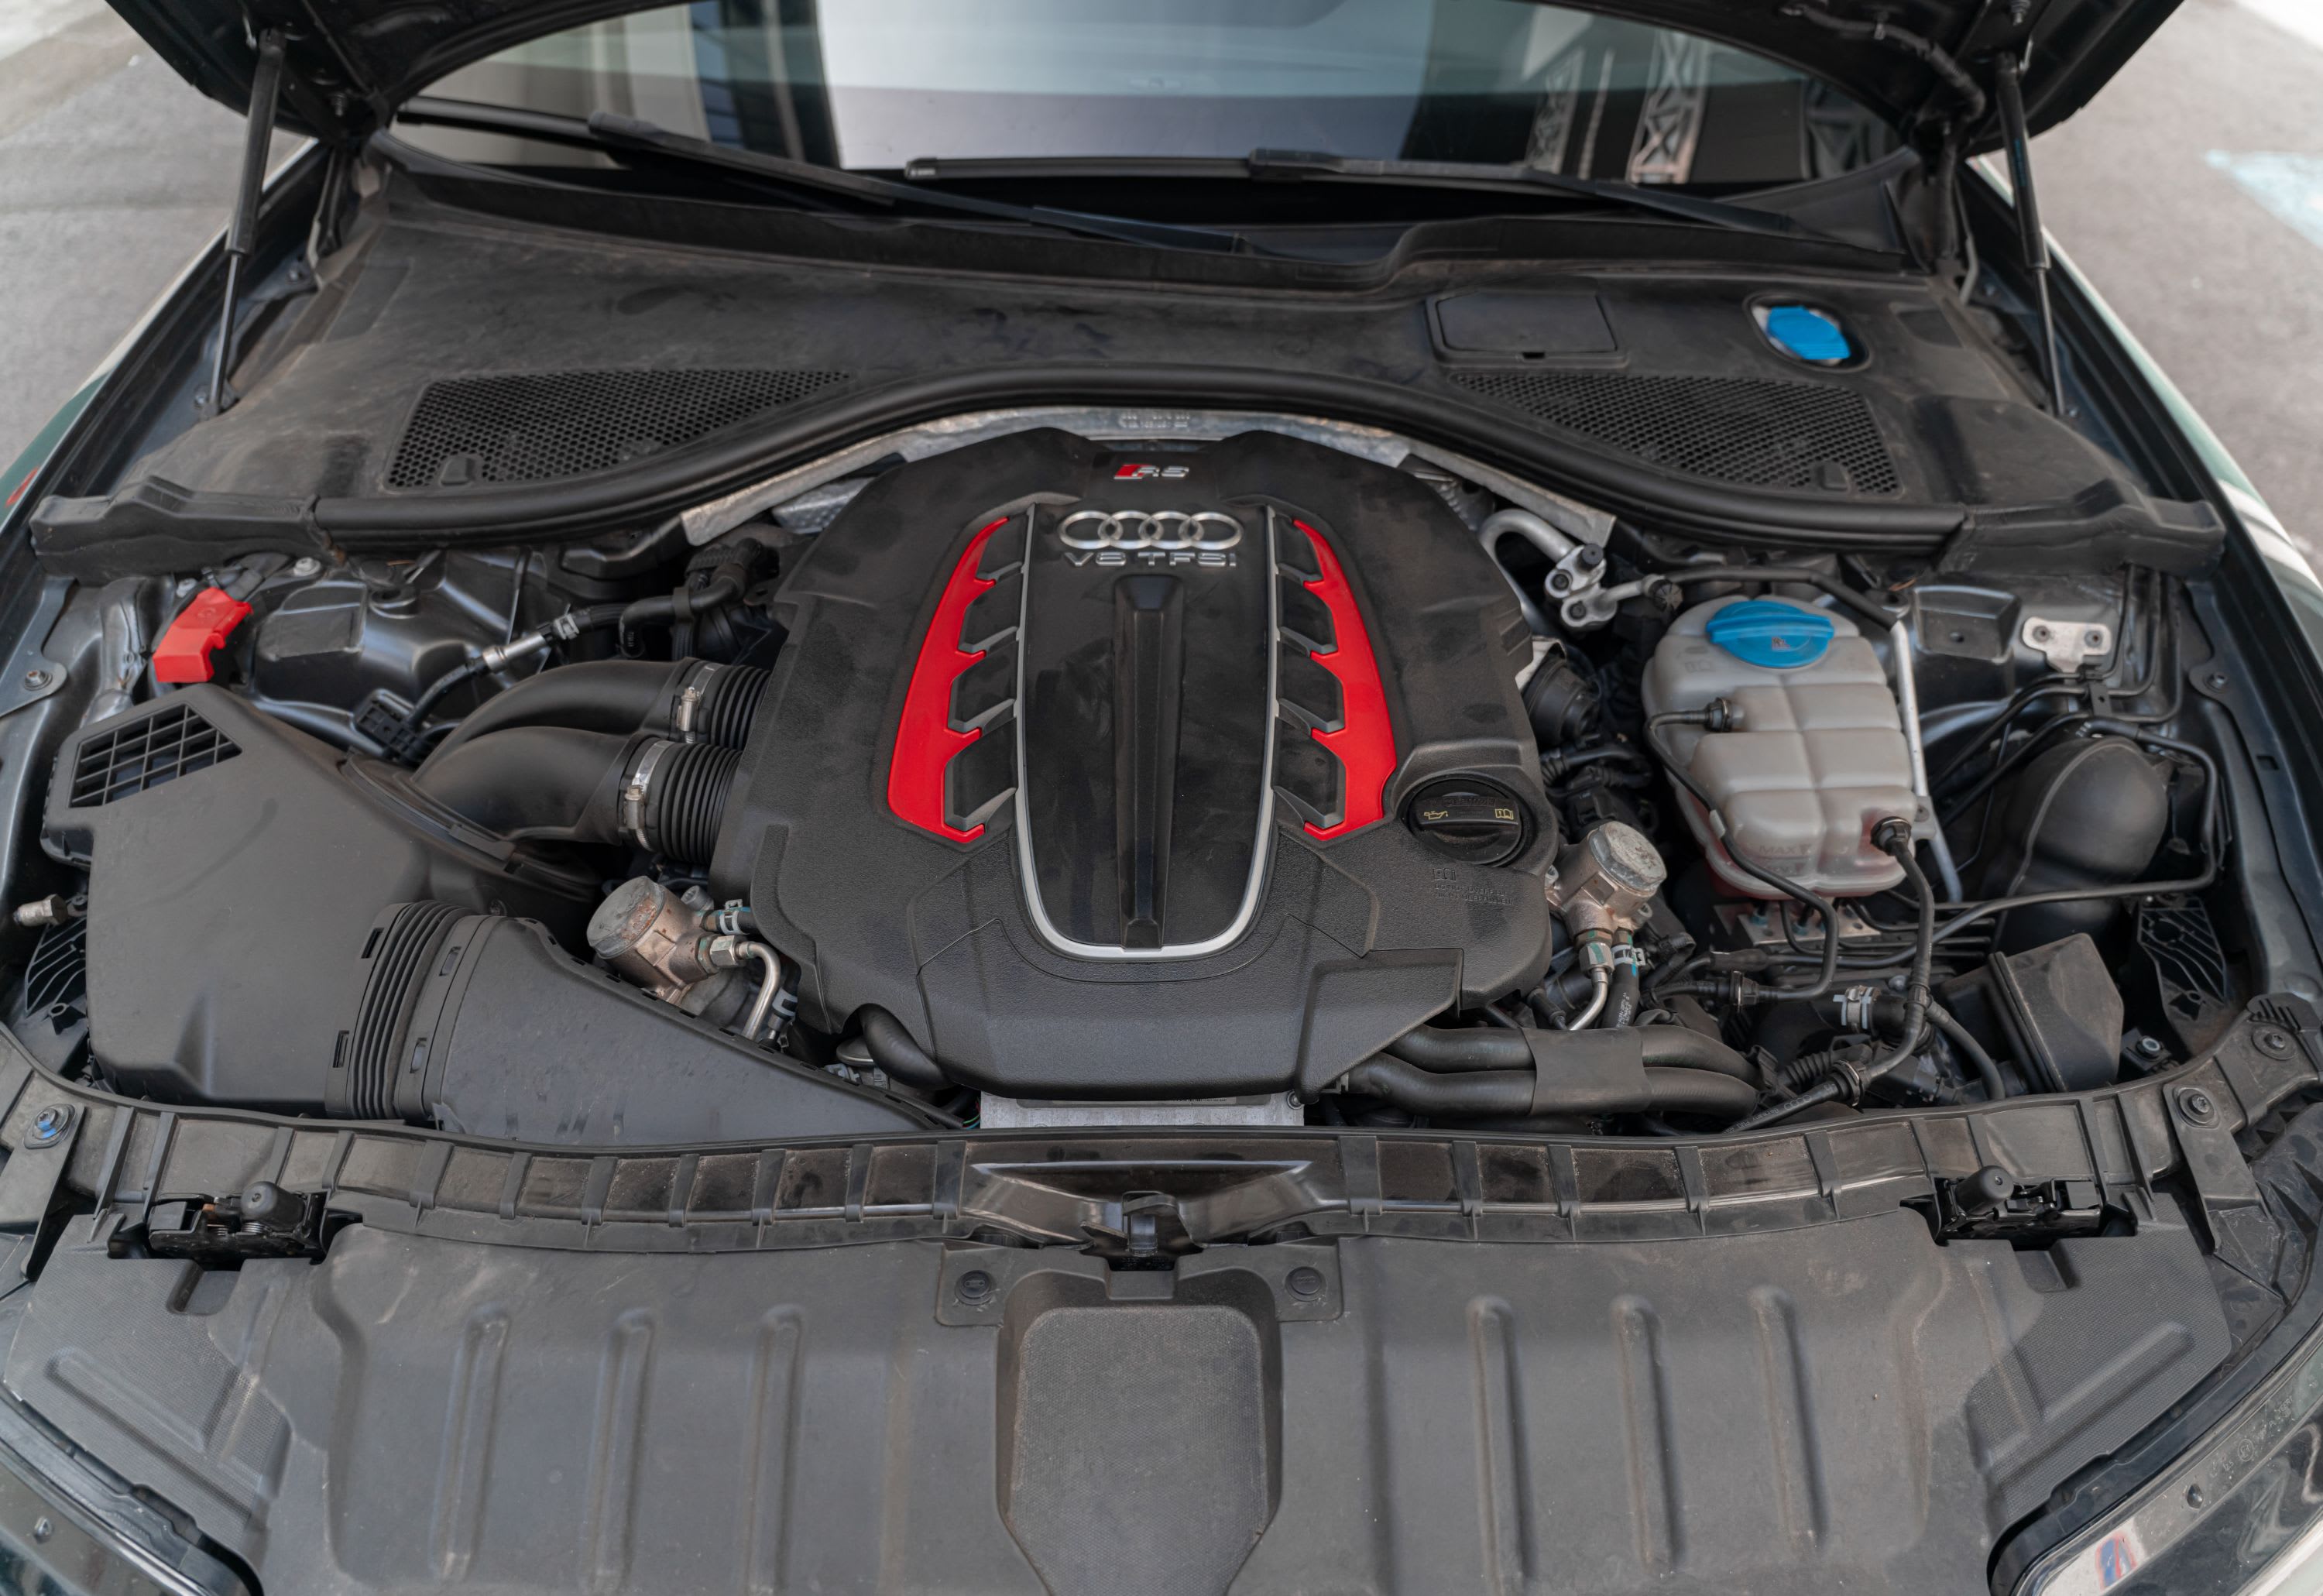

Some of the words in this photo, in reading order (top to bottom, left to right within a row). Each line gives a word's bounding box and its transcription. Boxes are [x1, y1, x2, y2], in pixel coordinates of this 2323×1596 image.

[1131, 465, 1189, 478] RS
[1065, 551, 1127, 567] V8
[1137, 551, 1237, 568] TFSI
